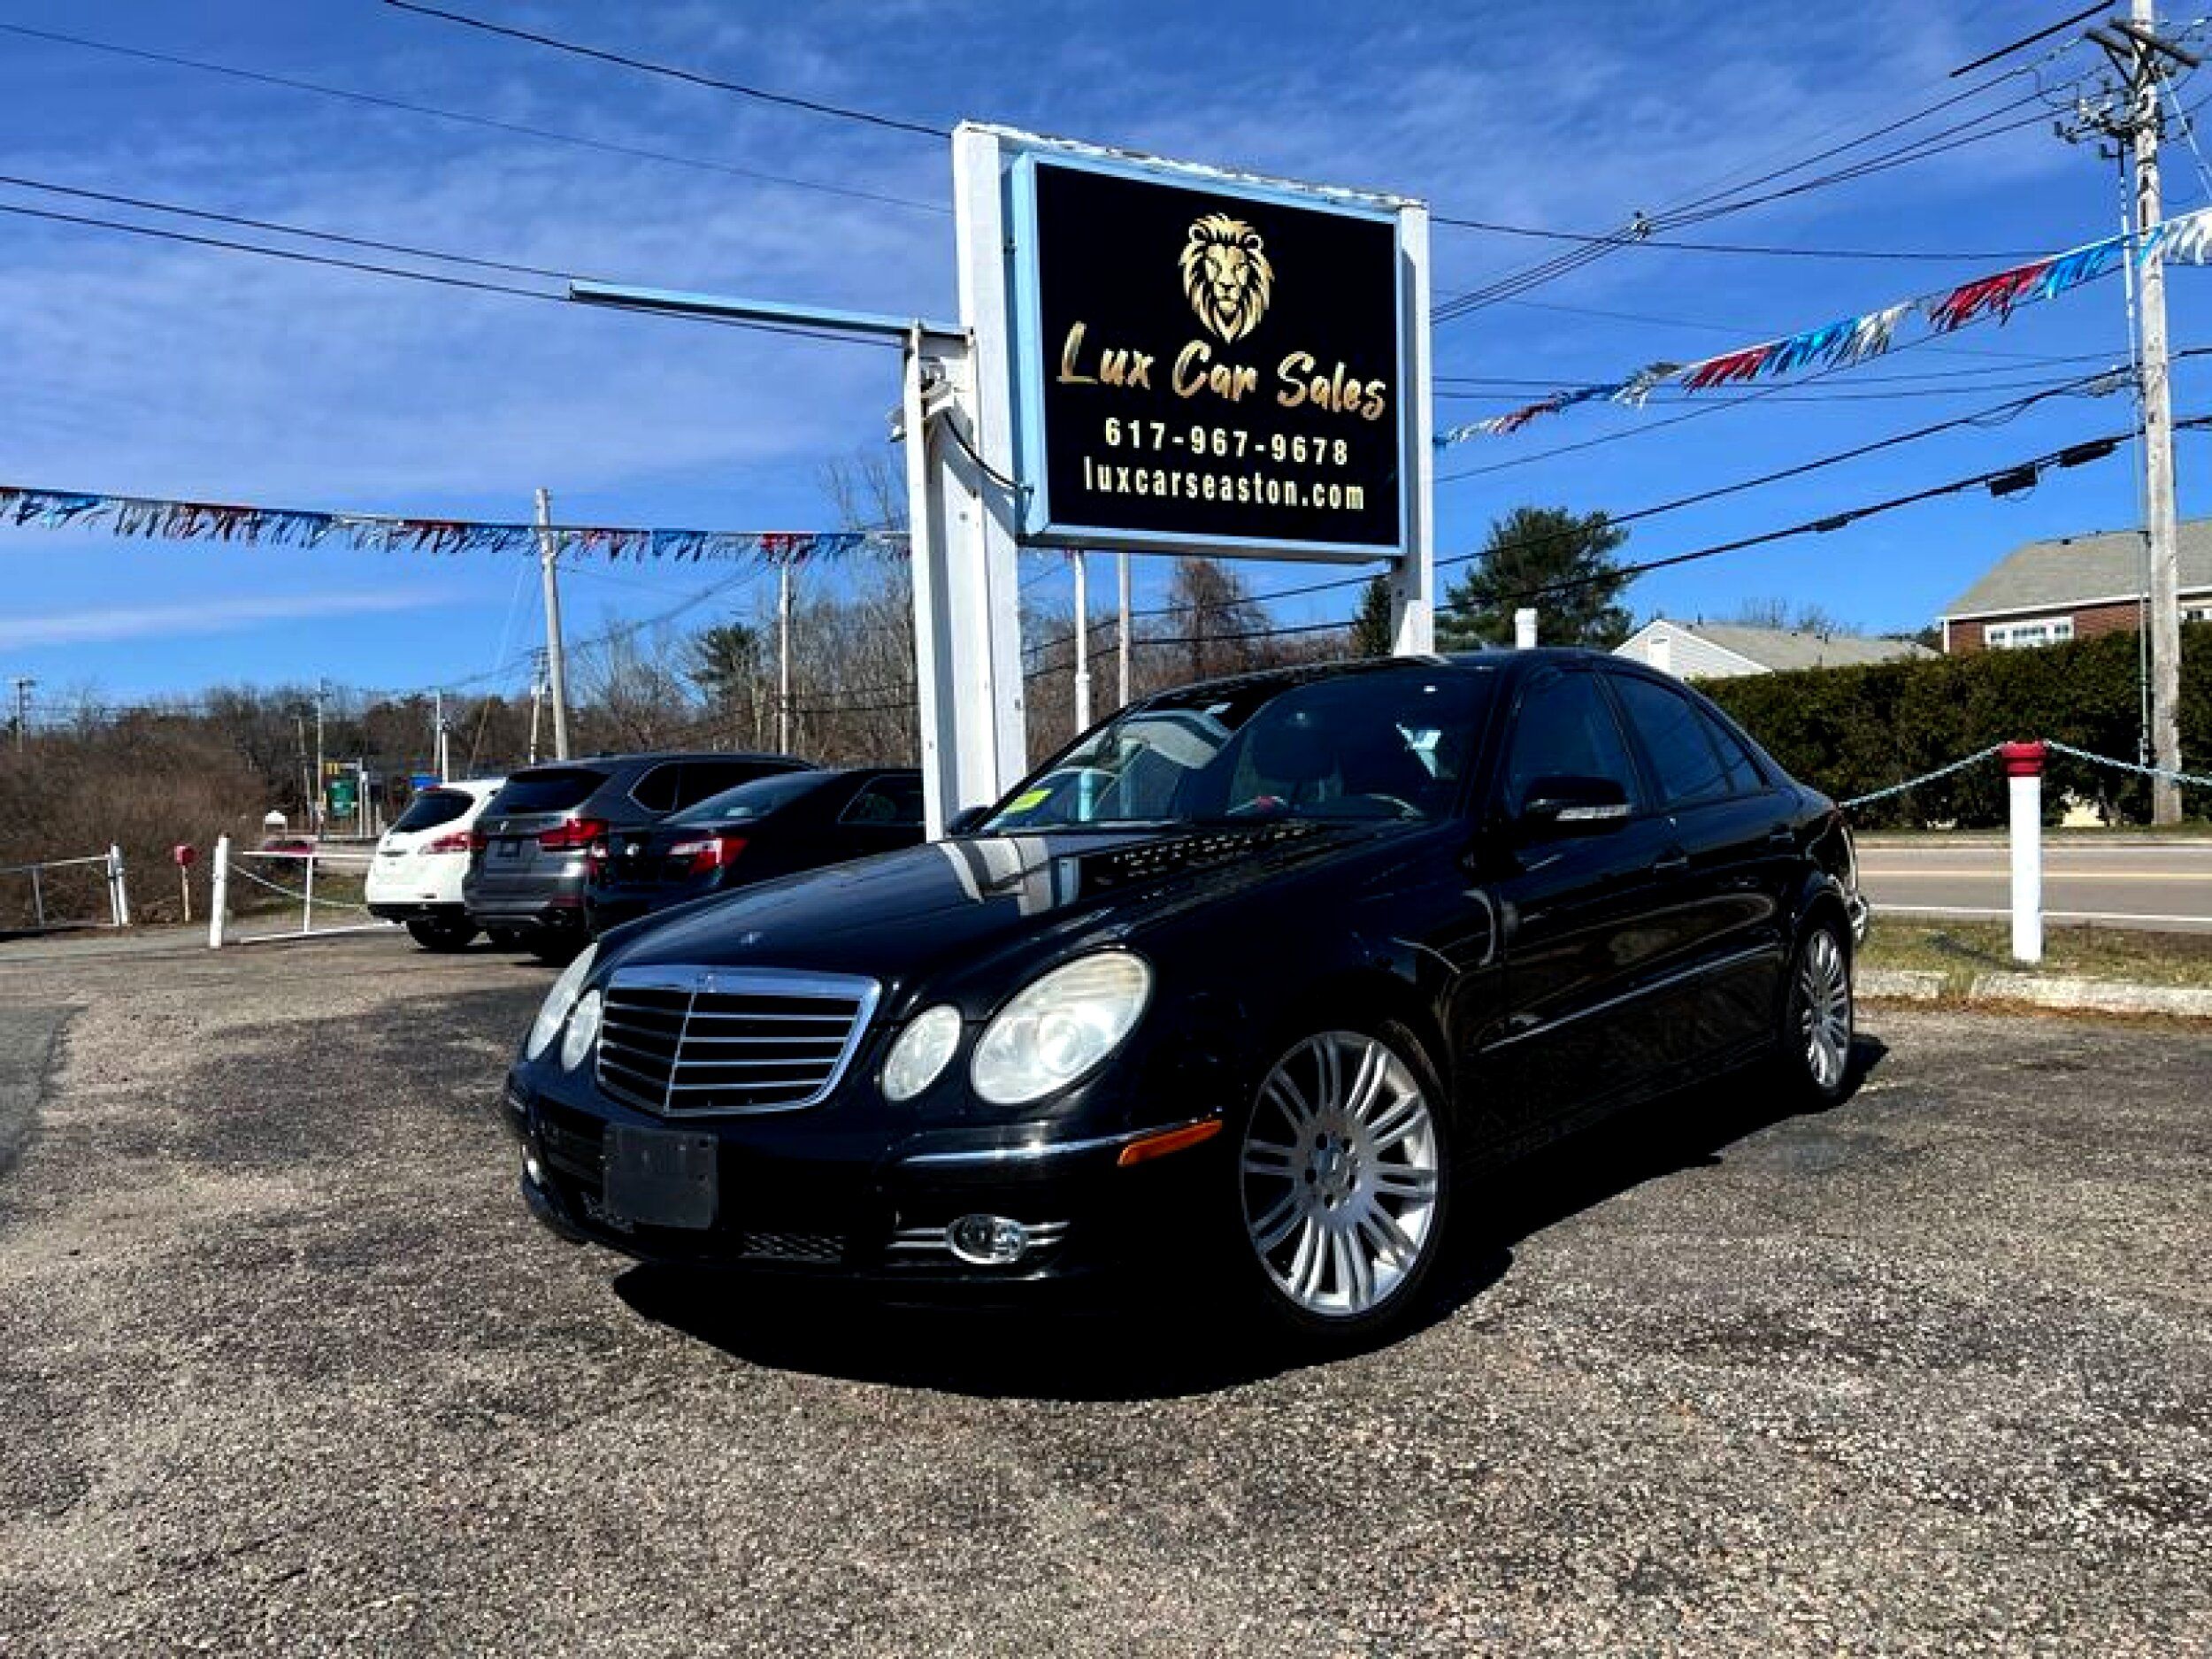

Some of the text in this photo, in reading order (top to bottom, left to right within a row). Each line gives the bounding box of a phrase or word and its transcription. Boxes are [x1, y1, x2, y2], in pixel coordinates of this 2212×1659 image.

[1056, 320, 1386, 420] Lux Car Sales
[1105, 417, 1348, 465] 617-967-9678
[1084, 456, 1364, 510] luxcarseaston.com
